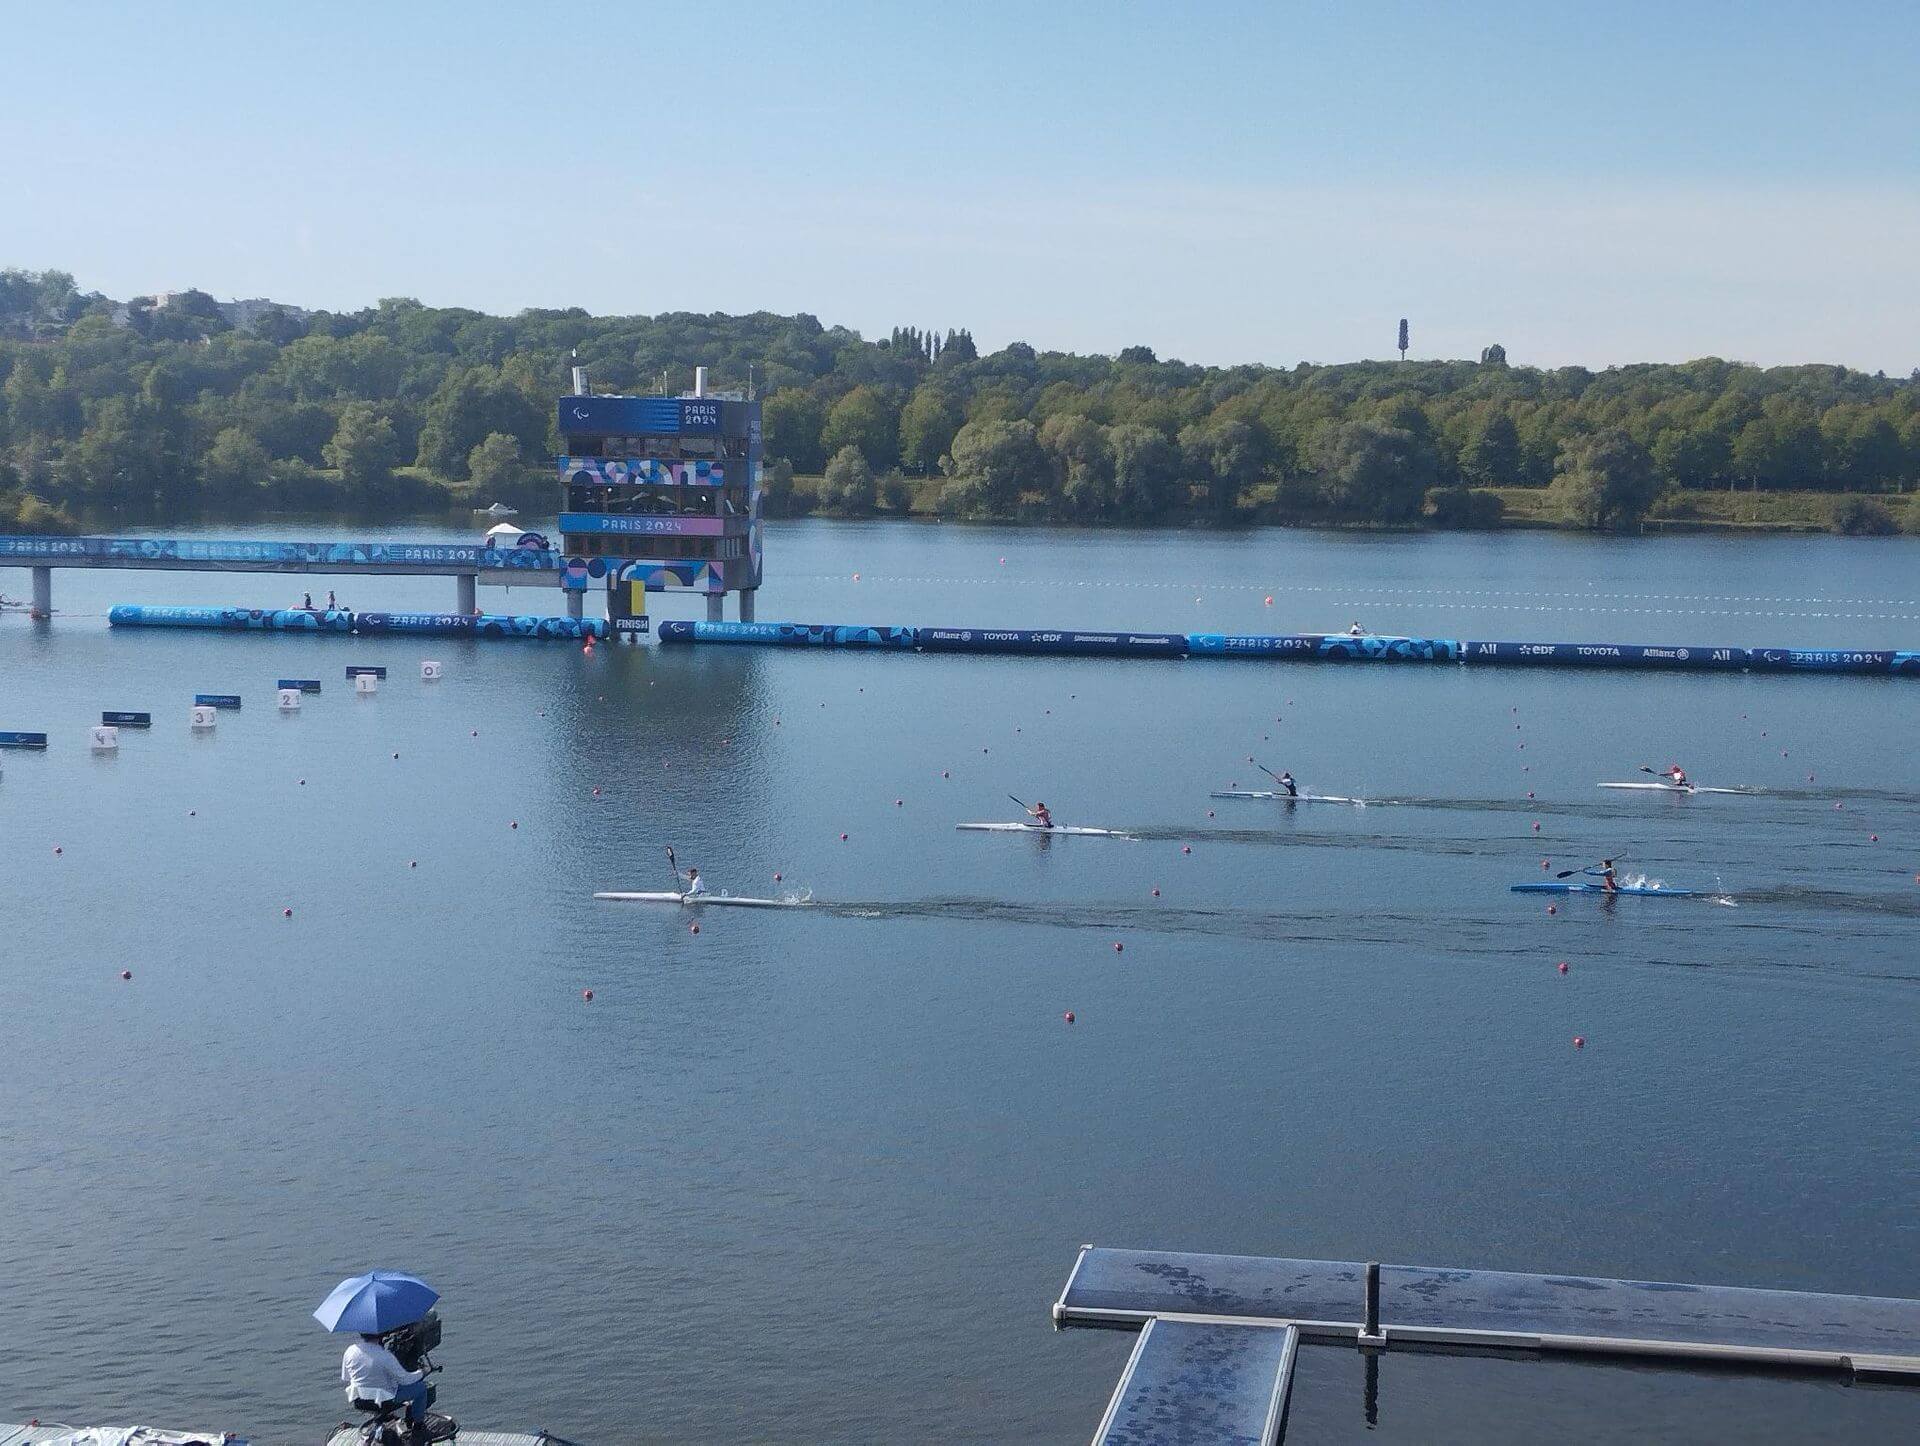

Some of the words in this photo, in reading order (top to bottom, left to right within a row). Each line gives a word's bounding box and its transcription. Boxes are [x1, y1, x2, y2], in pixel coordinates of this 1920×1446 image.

[684, 405, 717, 415] PARIS
[684, 415, 717, 425] 2024
[602, 519, 641, 530] PARIS
[646, 521, 682, 532] 2024
[404, 549, 444, 560] PARIS
[393, 616, 431, 625] PARIS
[435, 616, 469, 627] 2024
[616, 619, 649, 630] FINISH
[698, 623, 737, 633] PARIS
[742, 625, 776, 635] 2024
[932, 631, 960, 640] Allianz
[983, 632, 1020, 641] TOYOTA
[1229, 638, 1270, 648] PARIS
[1273, 639, 1312, 649] 2024
[1577, 646, 1621, 656] TOYOTA
[1643, 648, 1676, 658] Allianz
[1796, 652, 1839, 663] PARIS
[1842, 653, 1882, 664] 2024
[283, 694, 291, 706] 2
[194, 712, 204, 724] 3
